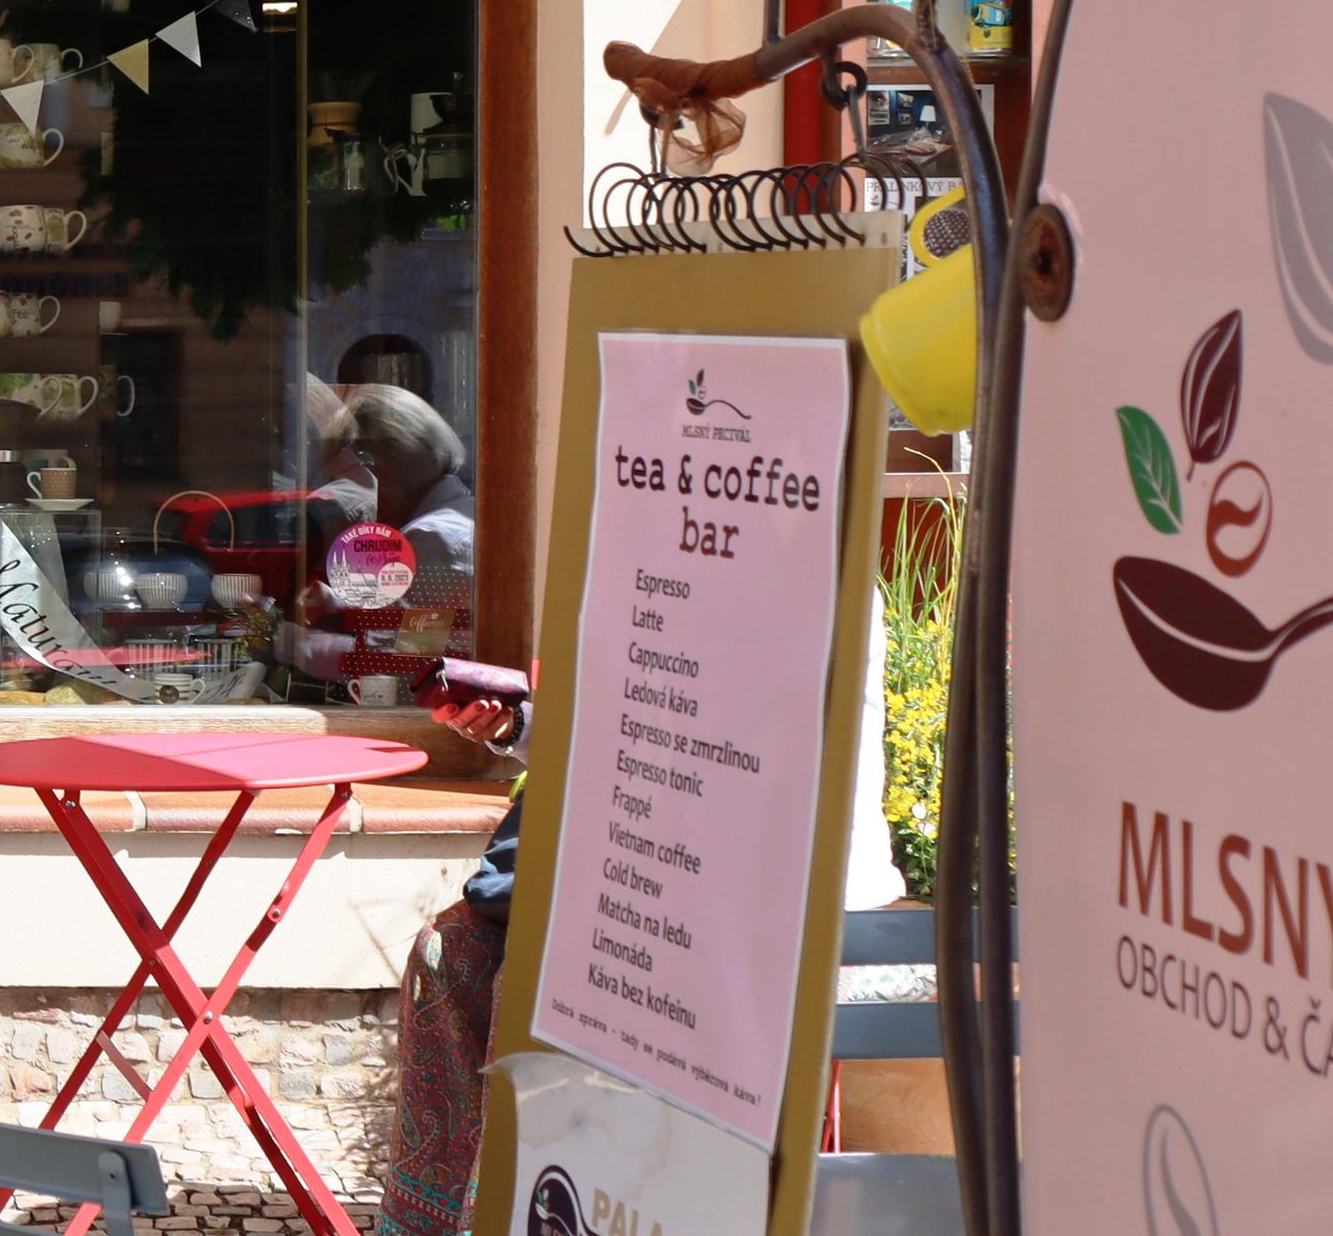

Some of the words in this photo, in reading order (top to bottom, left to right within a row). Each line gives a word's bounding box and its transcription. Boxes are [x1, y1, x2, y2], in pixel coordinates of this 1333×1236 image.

[615, 445, 666, 492] tea
[677, 454, 693, 494] &
[704, 455, 821, 512] coffee
[353, 539, 402, 552] CHRUDIM
[679, 506, 740, 559] bar
[635, 569, 691, 600] Espresso
[631, 606, 664, 632] Latte
[628, 642, 699, 678] Cappuccino
[624, 678, 667, 711] Ledová
[668, 687, 698, 717] káva
[620, 714, 671, 751] Espresso
[674, 733, 689, 751] se
[691, 736, 761, 774] zmrzlinou
[617, 750, 667, 787] Espresso
[669, 764, 704, 797] tonic
[612, 786, 652, 821] Frappé
[609, 820, 655, 857] Vietnam
[657, 840, 701, 875] coffee
[603, 858, 629, 888] Cold
[629, 866, 663, 900] brew
[598, 893, 641, 932] Matcha
[642, 917, 661, 937] na
[662, 919, 692, 950] ledu
[592, 928, 653, 973] Limonáda
[588, 963, 618, 996] Káva
[621, 977, 644, 1007] bez
[647, 986, 697, 1030] kofeinu
[1116, 935, 1253, 1041] OBCHOD
[1263, 996, 1290, 1061] &
[620, 1030, 640, 1051] tady
[643, 1043, 653, 1055] se
